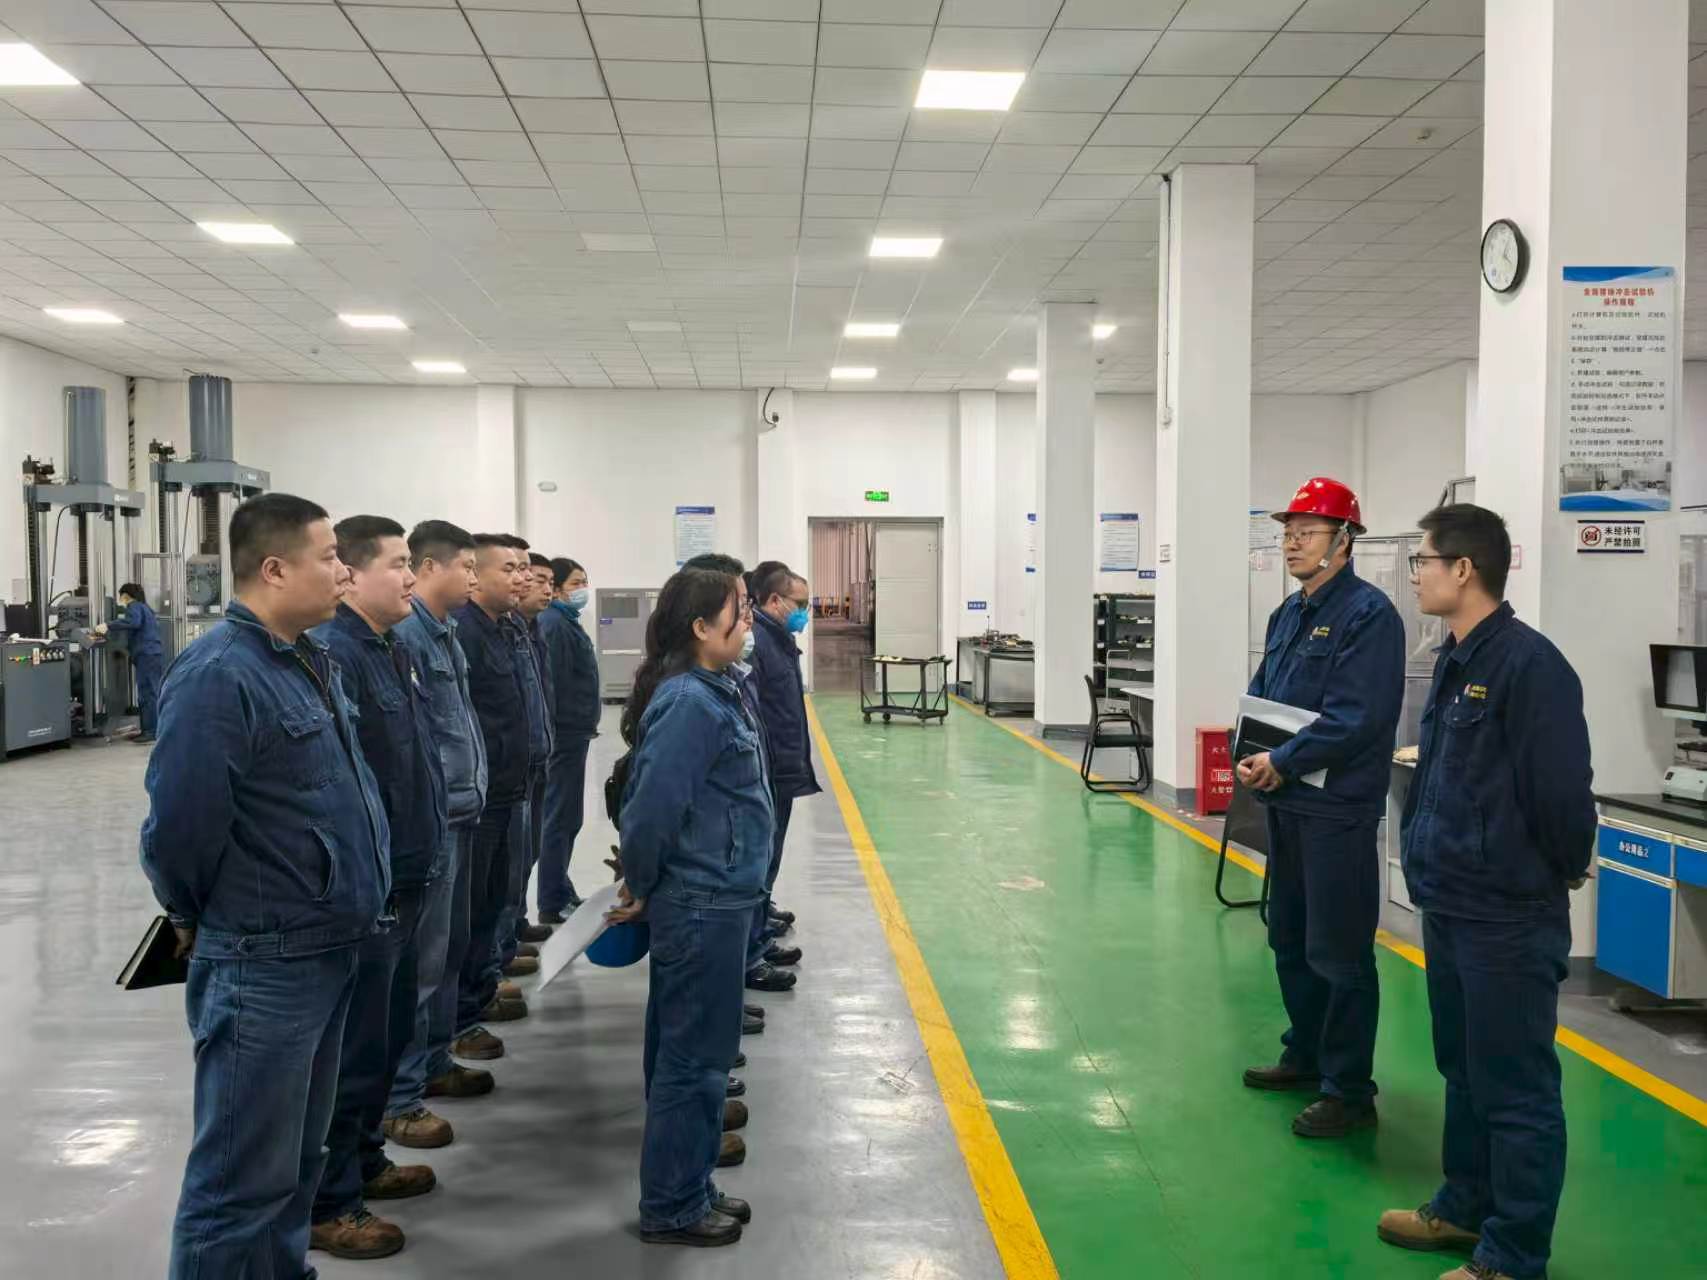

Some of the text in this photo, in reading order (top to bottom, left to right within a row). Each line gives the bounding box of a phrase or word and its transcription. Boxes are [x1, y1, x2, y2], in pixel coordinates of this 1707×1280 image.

[1603, 298, 1635, 306] 操作规程
[1604, 526, 1641, 536] 未经许可
[1604, 537, 1641, 547] 严禁拍照
